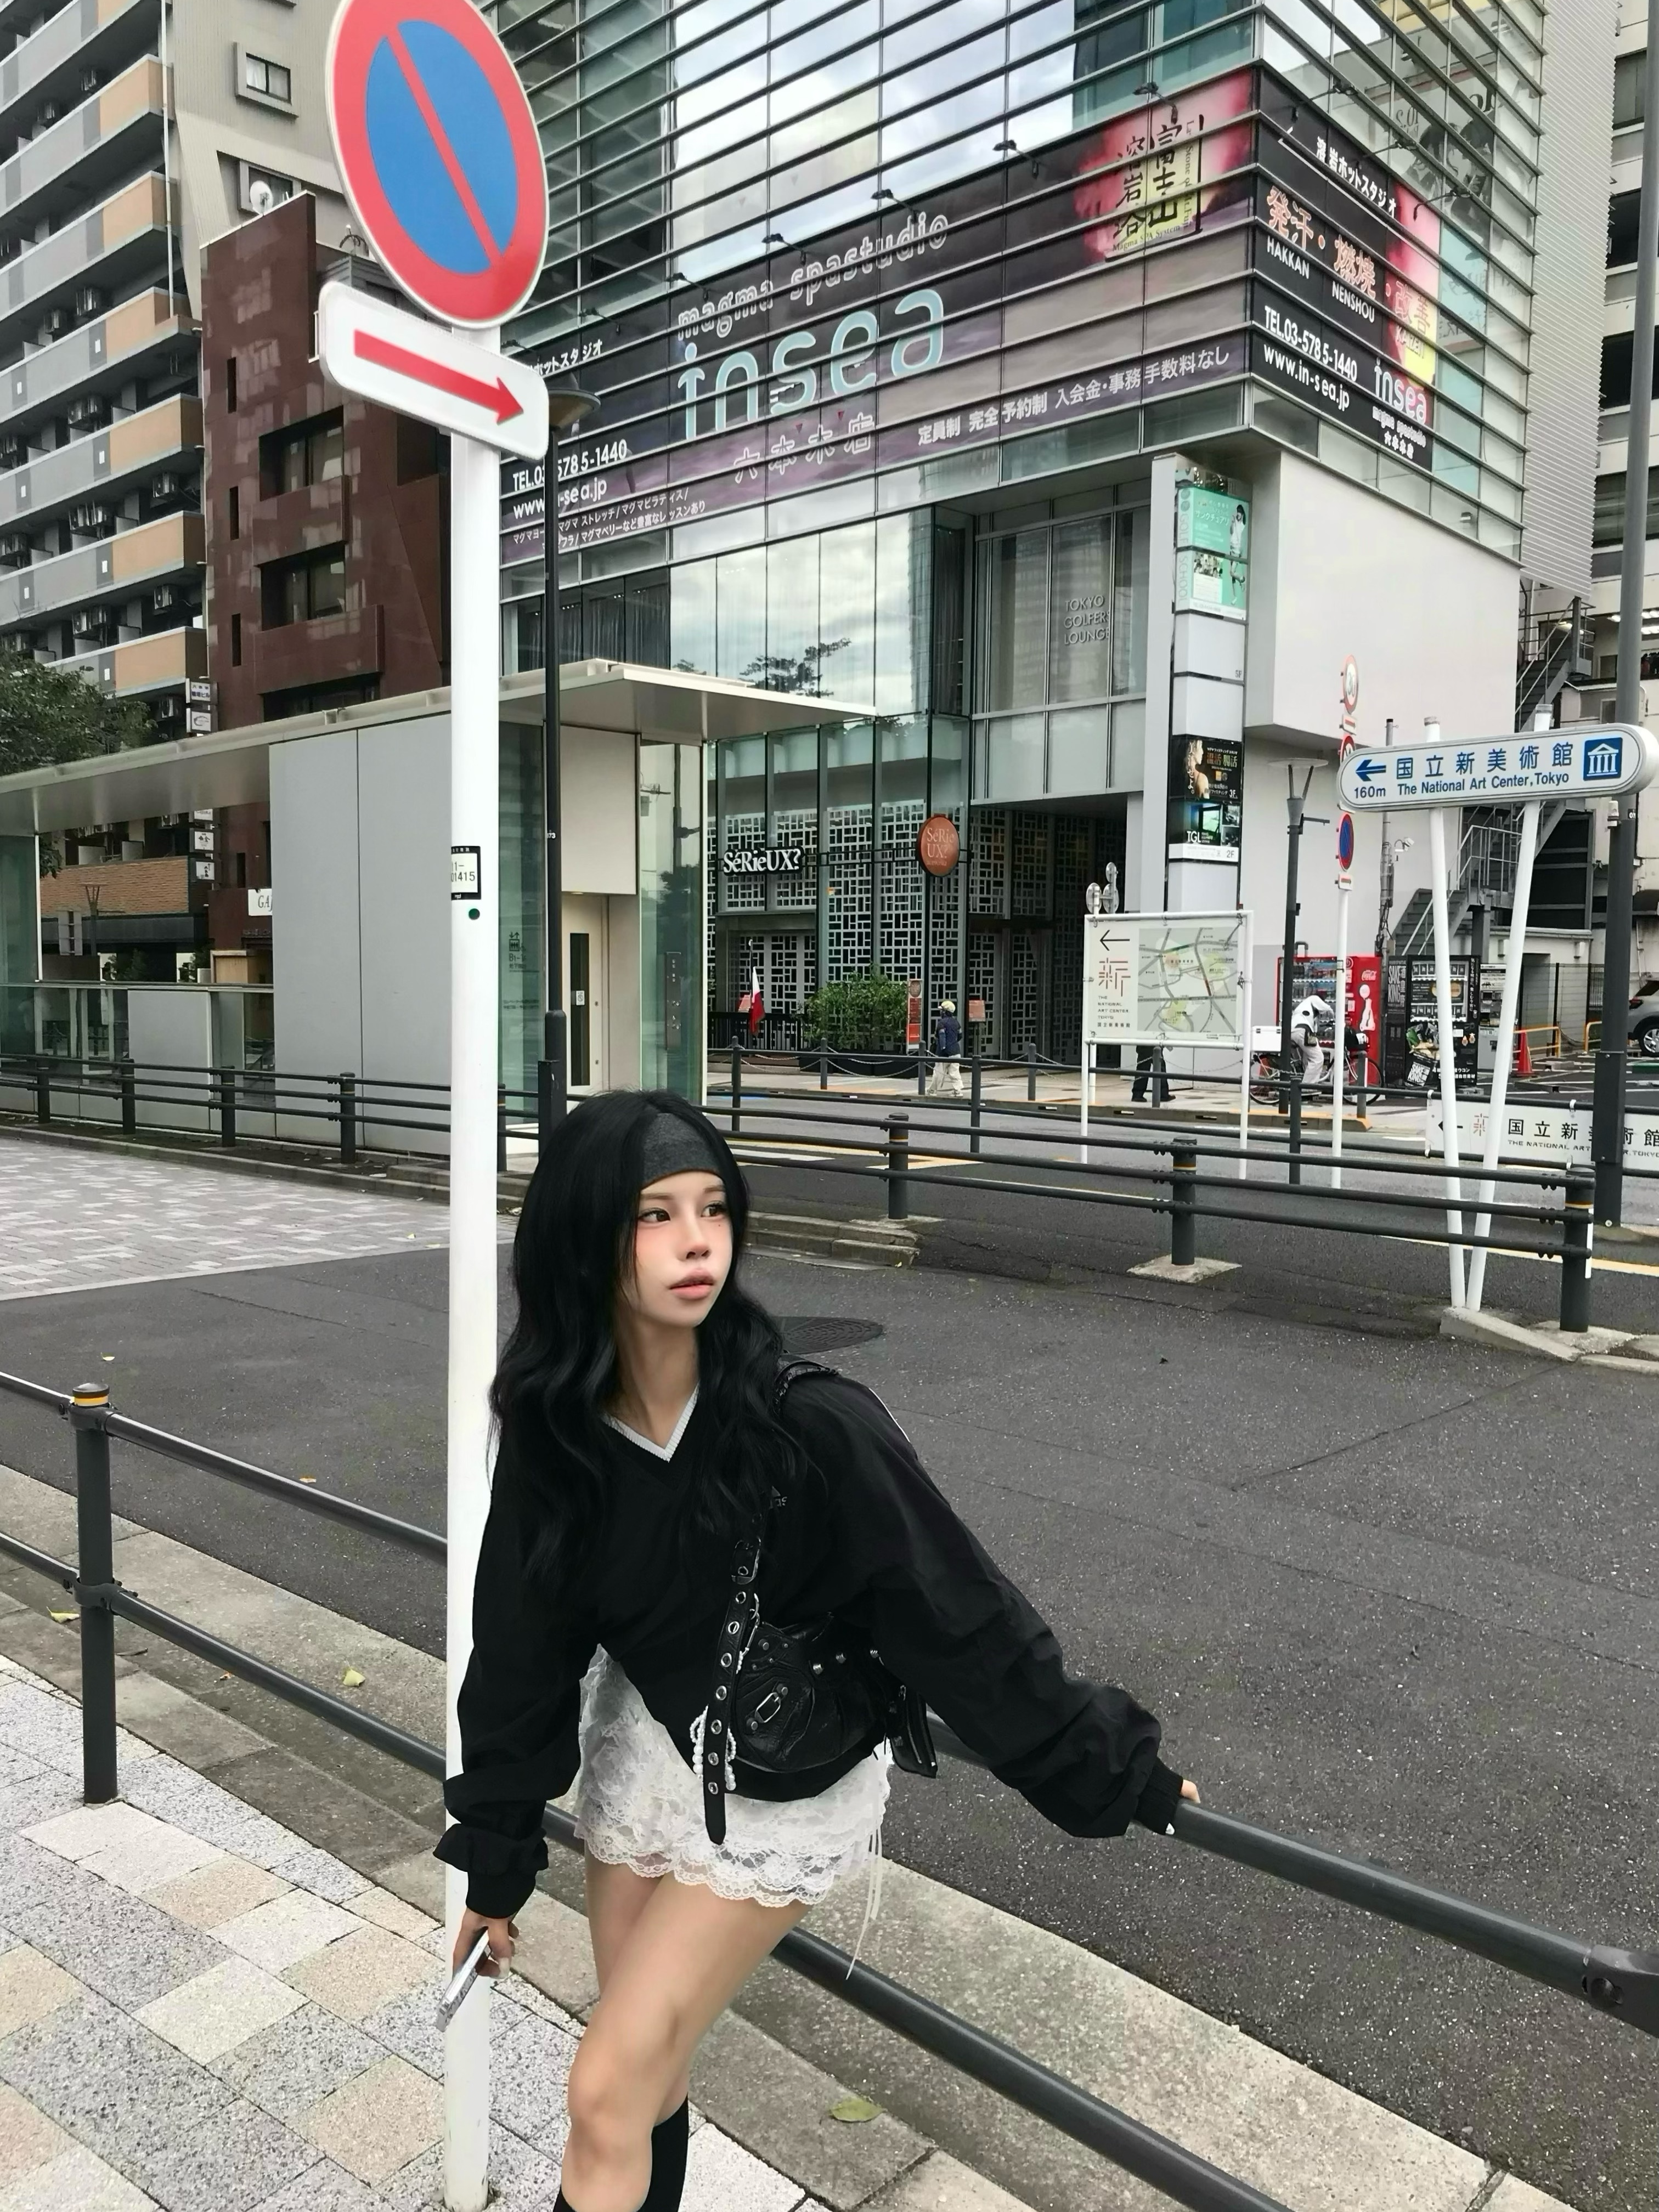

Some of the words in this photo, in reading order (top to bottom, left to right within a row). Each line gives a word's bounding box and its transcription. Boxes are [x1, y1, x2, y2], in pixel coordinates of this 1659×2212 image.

[1316, 136, 1397, 219] 溶岩ホットスタジオ
[1267, 237, 1310, 279] HAKKAN
[678, 279, 774, 339] magma
[790, 212, 949, 306] spastudio
[1332, 283, 1375, 324] NENSHOU
[678, 288, 944, 441] insea
[1263, 343, 1350, 412] www.in-sea.jp
[1374, 357, 1427, 425] insea
[917, 415, 961, 446] 定員制
[734, 411, 875, 484] 六本木店
[1064, 595, 1104, 612] TOKYO
[1396, 741, 1573, 780] 国立新美術館
[1354, 786, 1386, 799] 160m
[1397, 783, 1417, 796] The
[1421, 780, 1465, 794] National
[1470, 778, 1487, 790] Art
[927, 827, 955, 844] SéRie
[1186, 830, 1201, 843] TGL
[723, 847, 802, 875] SéRieUX?
[927, 843, 948, 859] UX?
[1226, 850, 1235, 858] 2F
[1388, 965, 1401, 985] SAKE
[1387, 984, 1401, 1003] KING
[1526, 1141, 1571, 1150] NATIONAL
